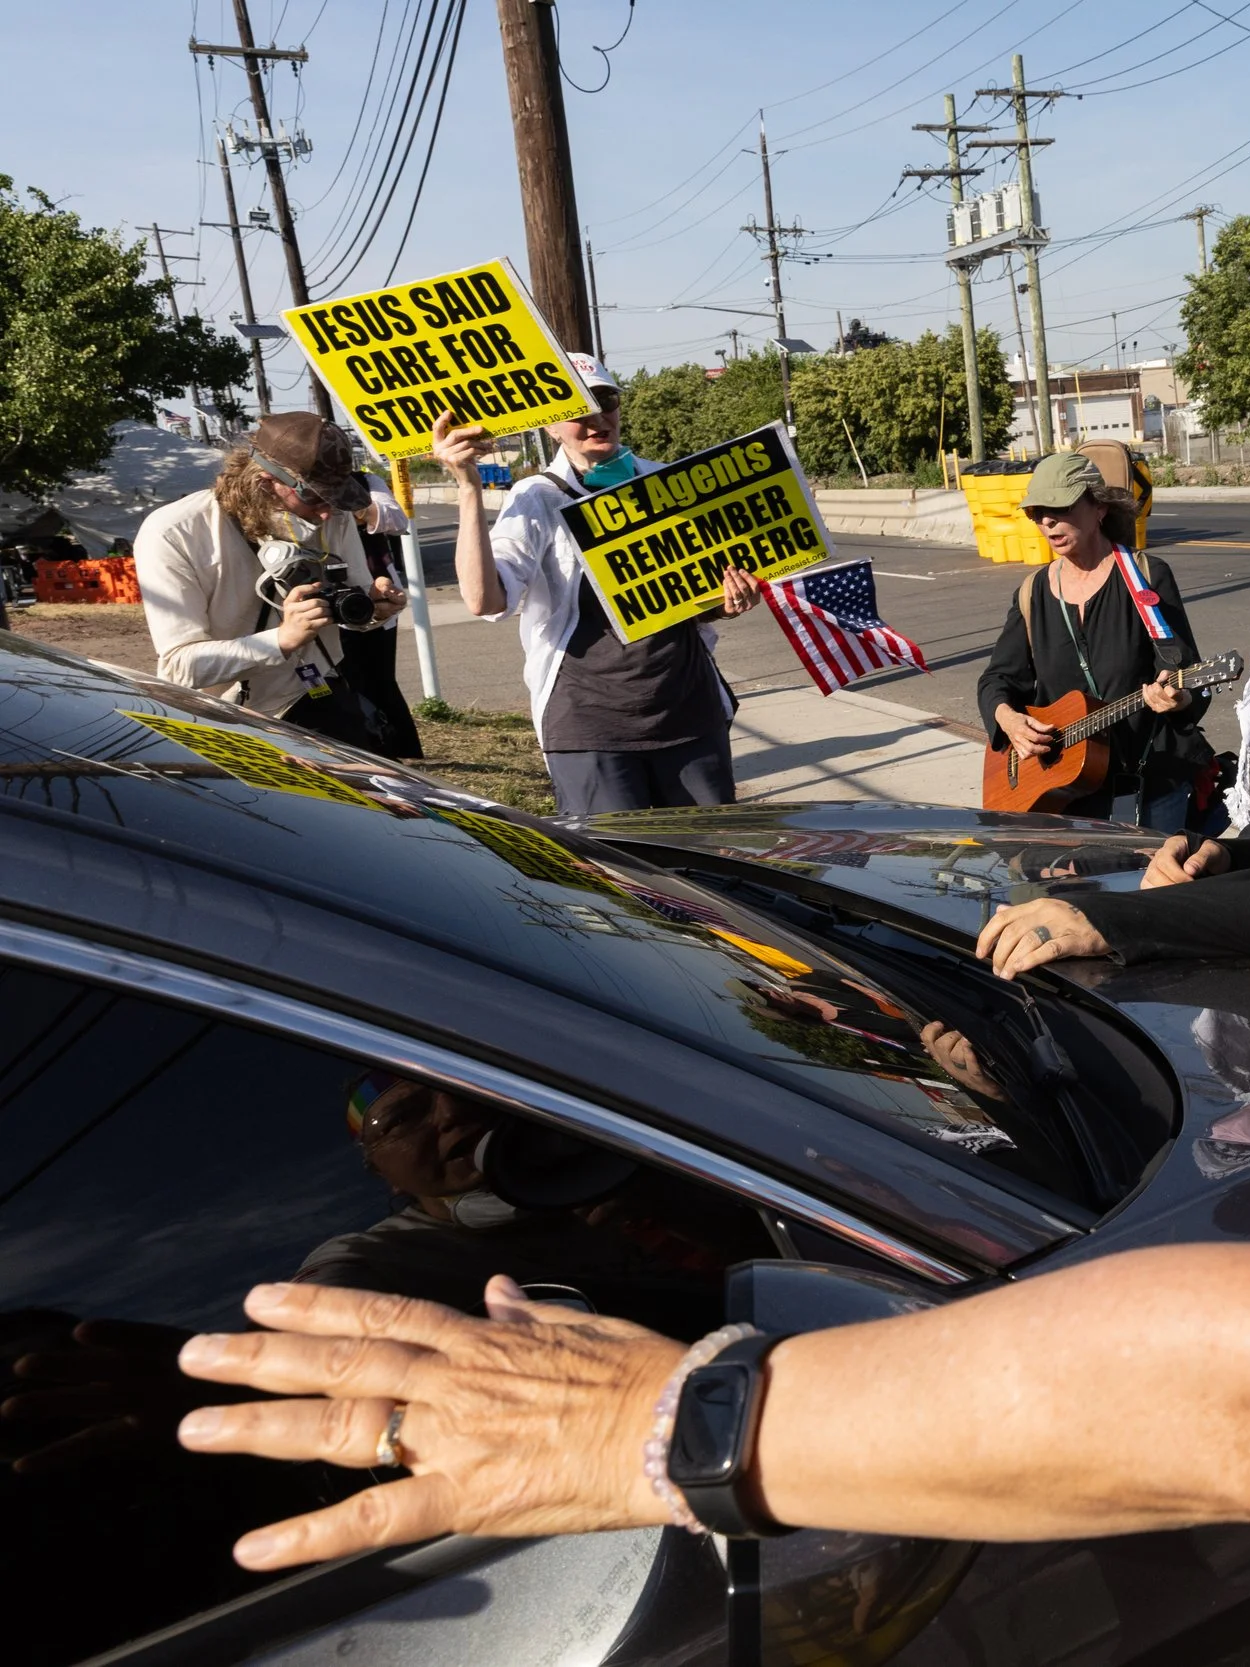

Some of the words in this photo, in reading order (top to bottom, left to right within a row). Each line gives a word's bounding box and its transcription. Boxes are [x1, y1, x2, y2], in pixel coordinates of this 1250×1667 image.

[300, 294, 417, 355] JESUS
[408, 271, 512, 329] SAID
[345, 339, 451, 395] CARE
[441, 323, 526, 375] FOR
[355, 361, 574, 442] STRANGERS
[391, 445, 424, 459] Parable
[526, 417, 548, 429] Luke
[548, 405, 589, 424] 10:30–37
[579, 486, 648, 538] ICE
[643, 441, 772, 513] Agents
[604, 484, 794, 585] REMEMBER
[612, 516, 819, 627] NUREMBERG
[763, 551, 827, 582] eAndResist.org
